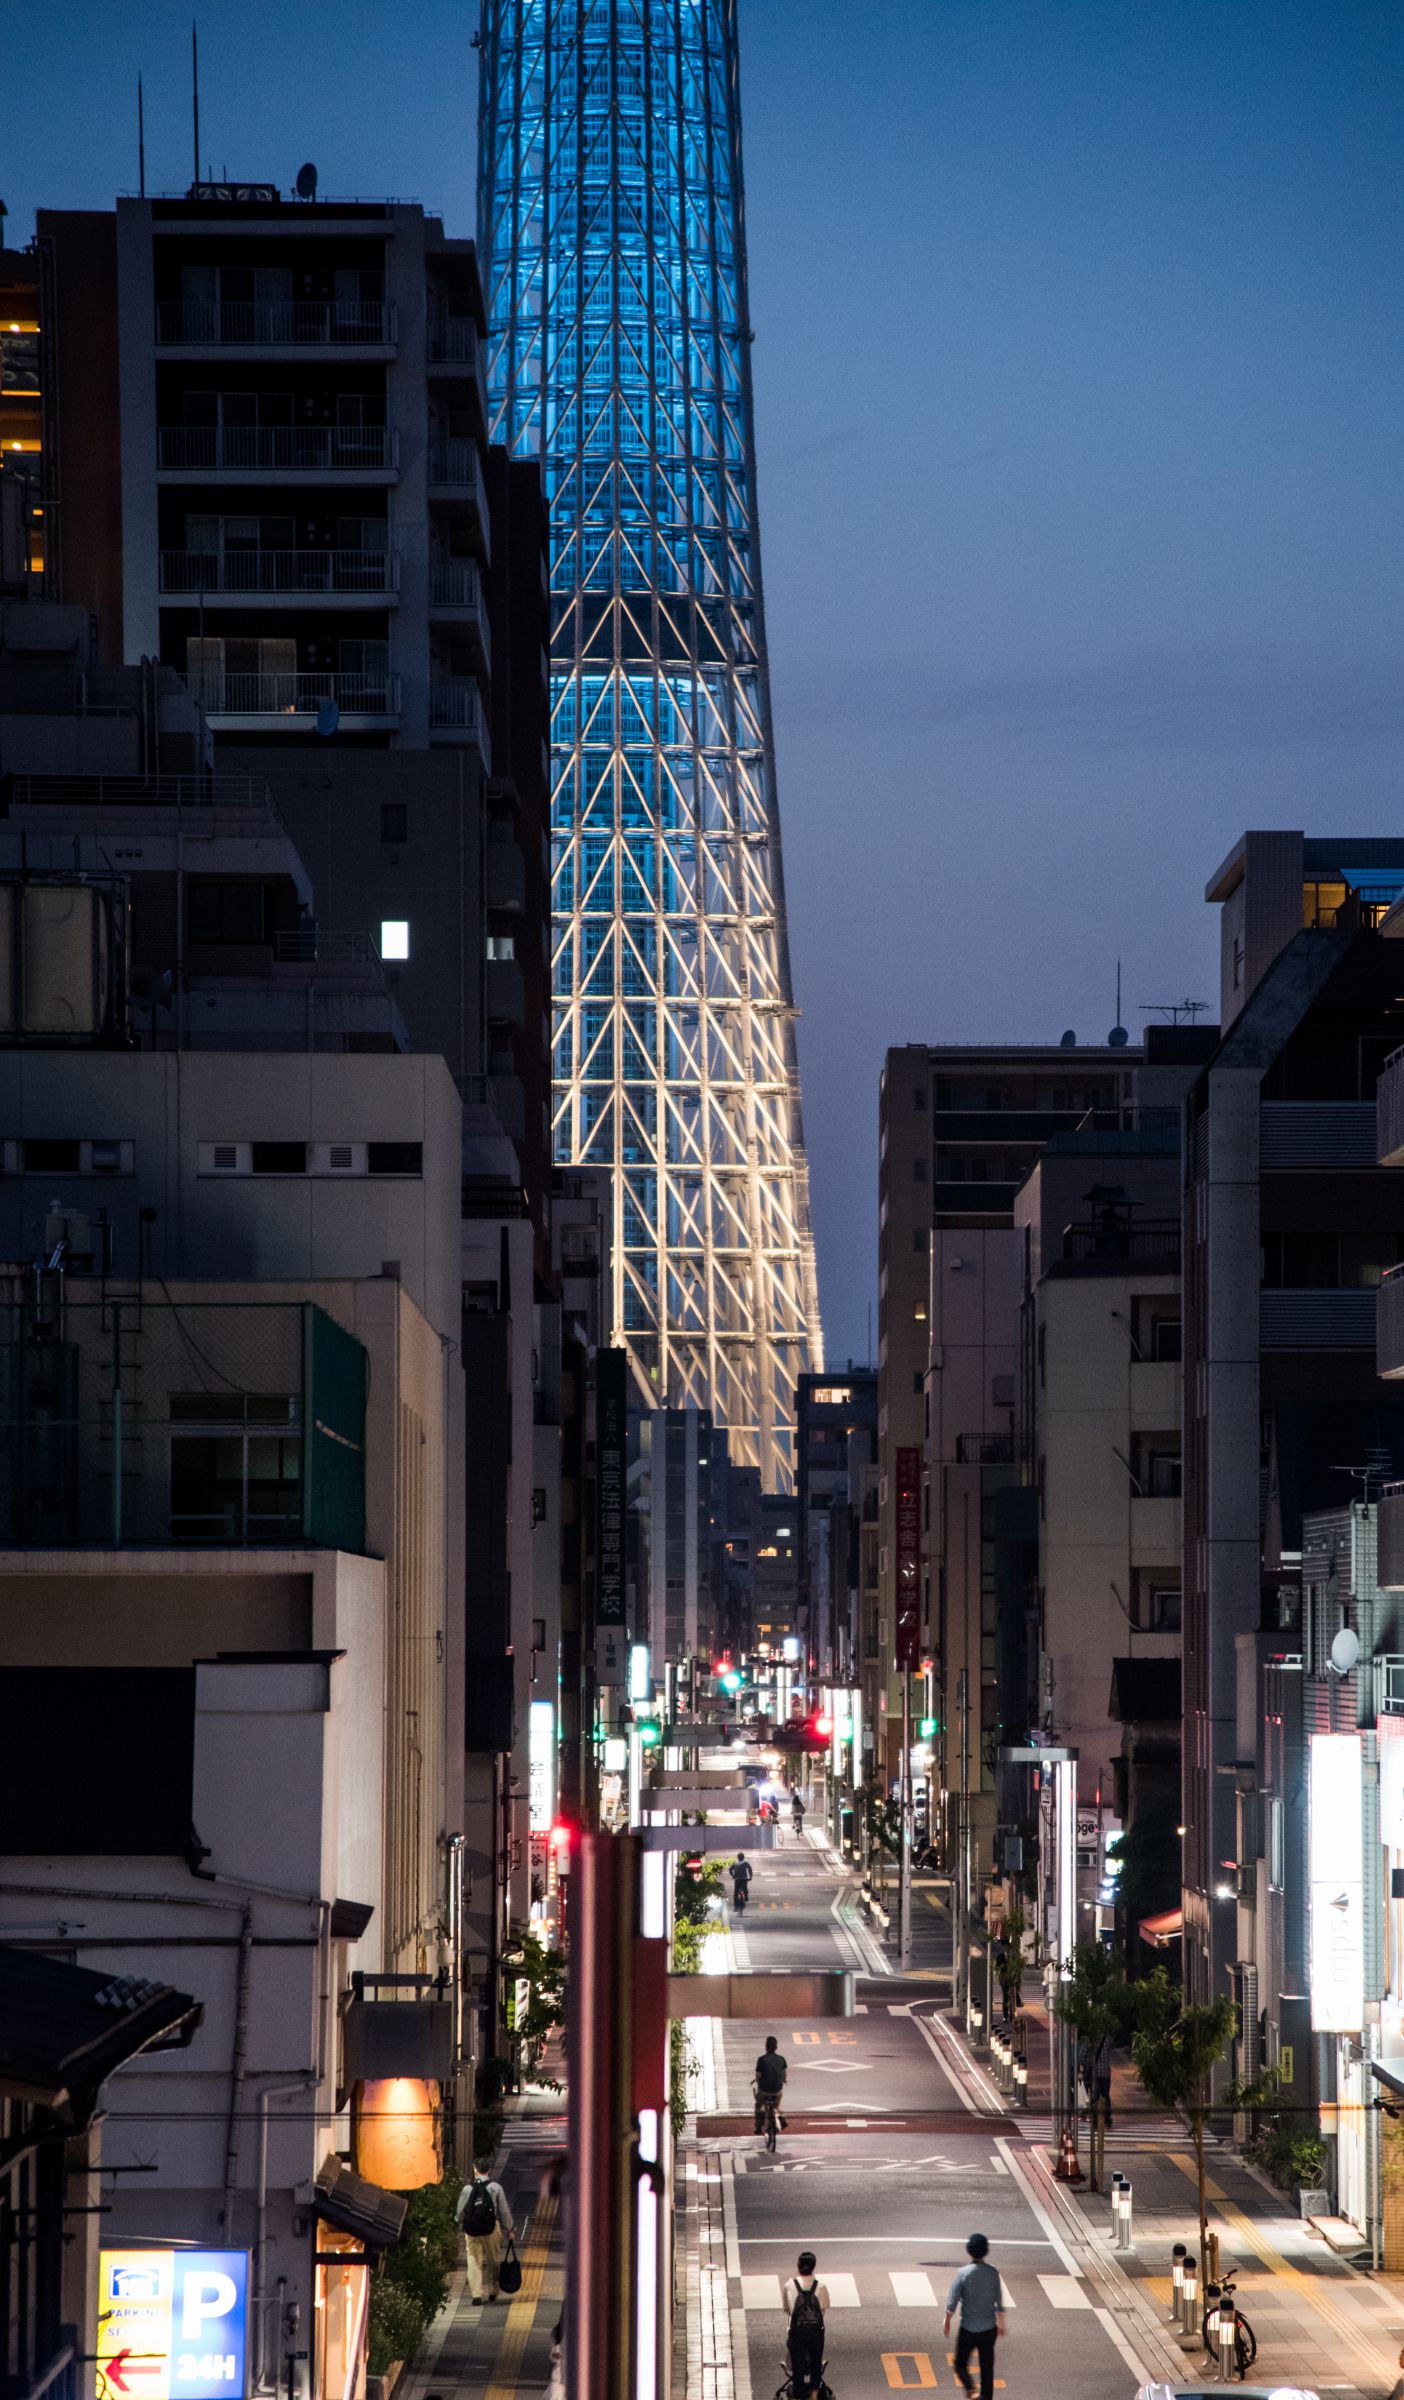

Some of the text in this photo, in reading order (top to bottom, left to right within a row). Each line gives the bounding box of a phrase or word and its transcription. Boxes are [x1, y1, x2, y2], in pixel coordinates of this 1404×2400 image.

[601, 1450, 621, 1614] 東京法律専門学校
[791, 2031, 859, 2045] 30
[181, 2271, 237, 2341] P
[175, 2352, 236, 2381] 24H
